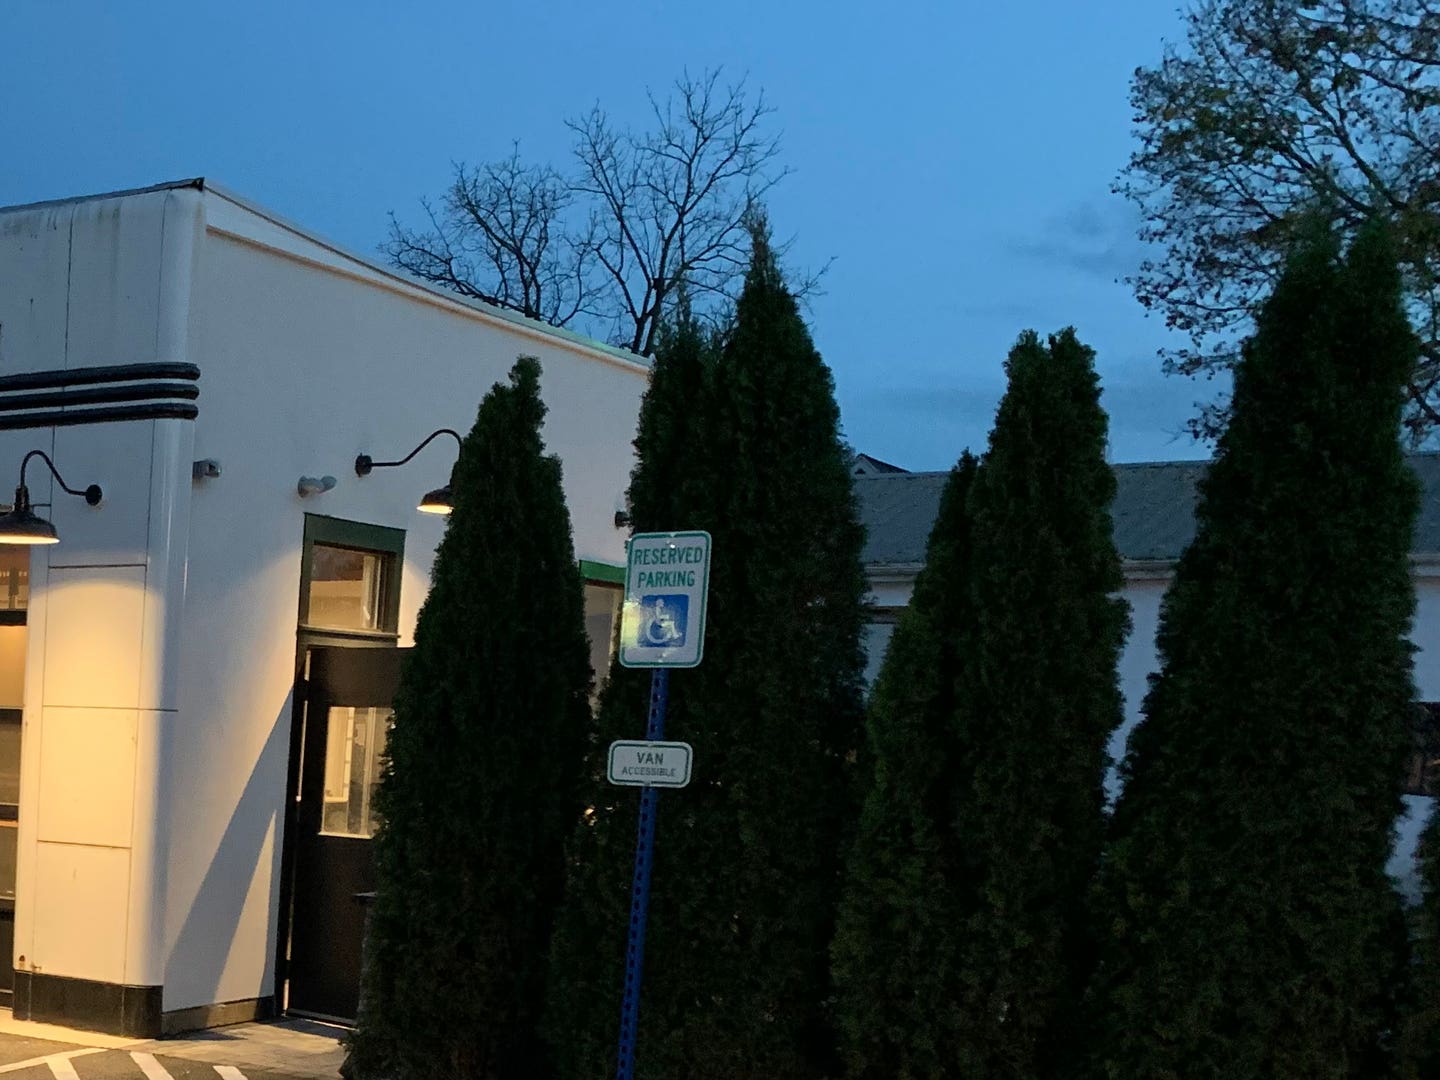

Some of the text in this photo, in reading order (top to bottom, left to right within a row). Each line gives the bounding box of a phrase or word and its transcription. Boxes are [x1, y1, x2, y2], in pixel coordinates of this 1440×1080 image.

[634, 547, 703, 565] RESERVED
[637, 571, 696, 588] PARKING
[637, 752, 664, 765] VAN
[622, 766, 677, 777] ACCESSIBLE
